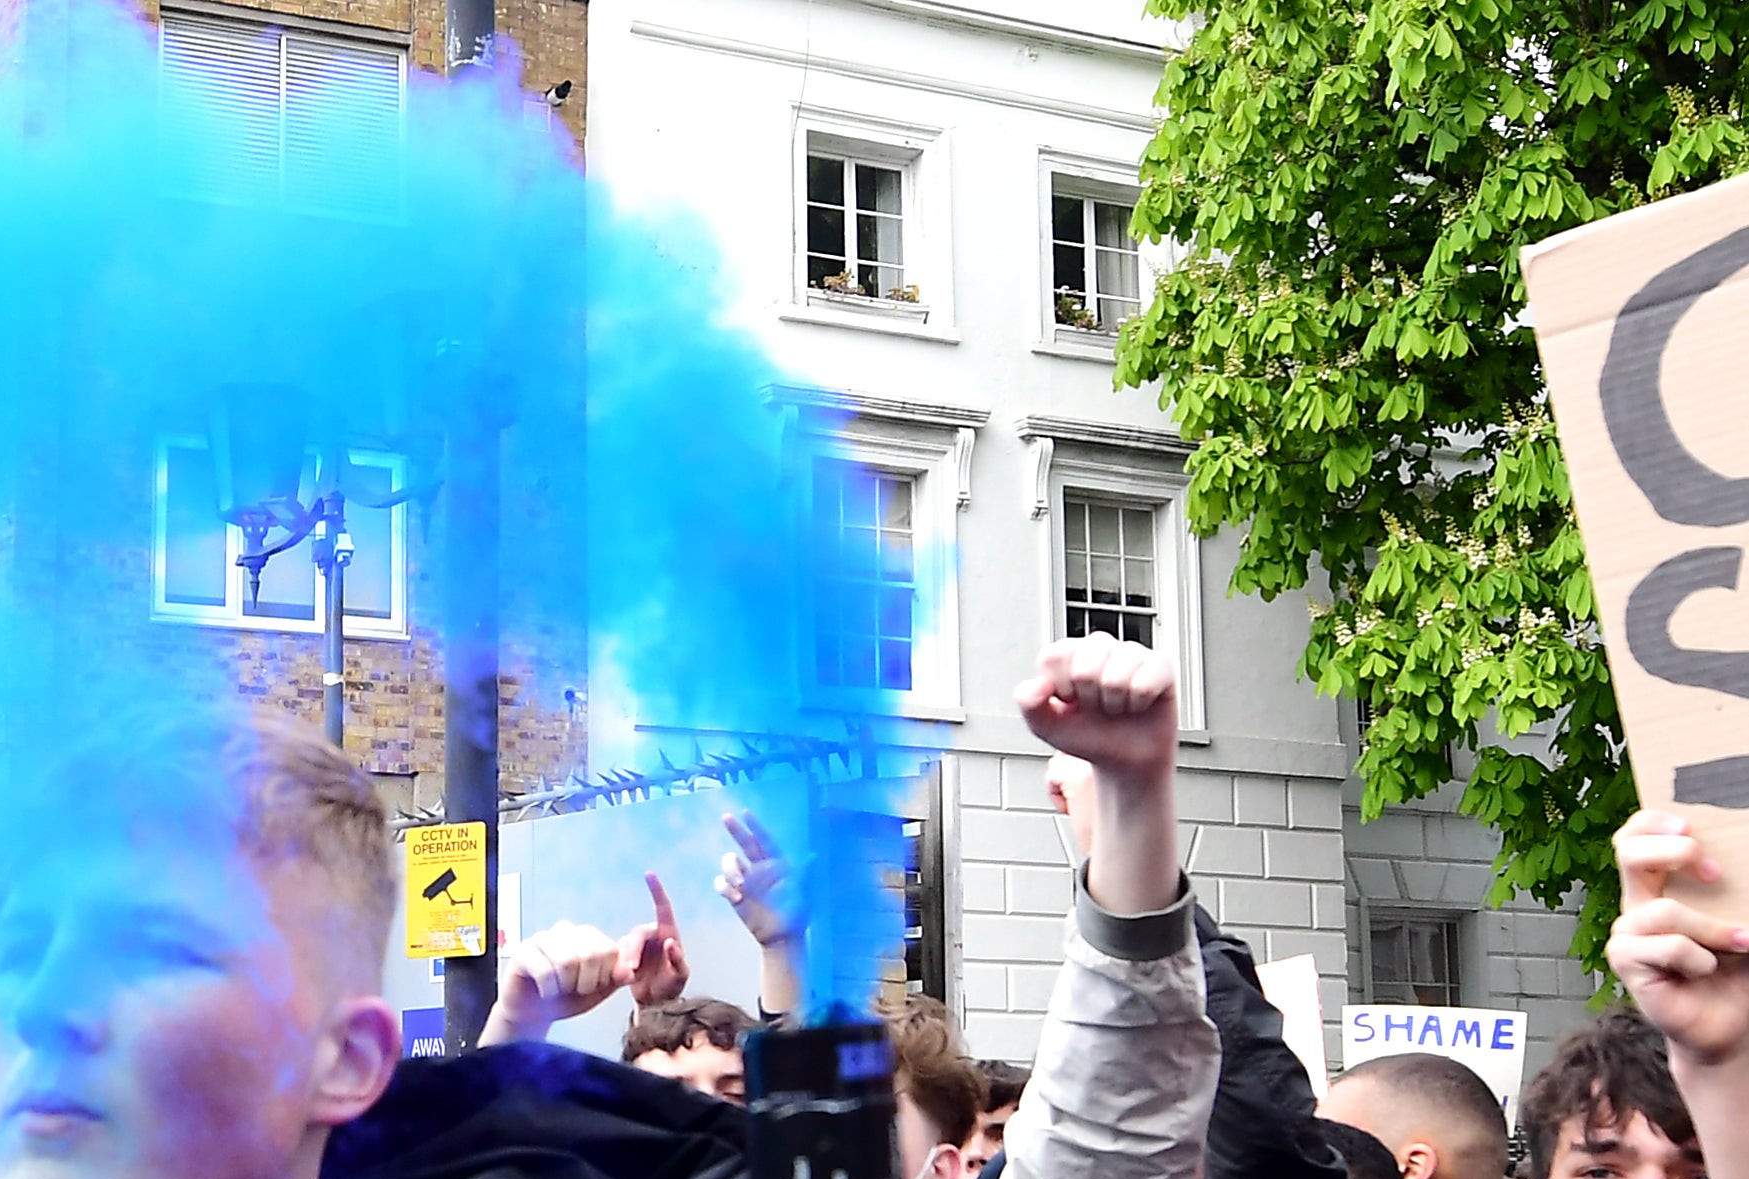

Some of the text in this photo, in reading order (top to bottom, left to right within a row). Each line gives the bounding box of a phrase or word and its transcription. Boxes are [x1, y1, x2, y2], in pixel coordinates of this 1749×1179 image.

[421, 828, 469, 842] CCTV IN
[413, 840, 477, 855] OPERATION
[1353, 1013, 1515, 1050] SHAME
